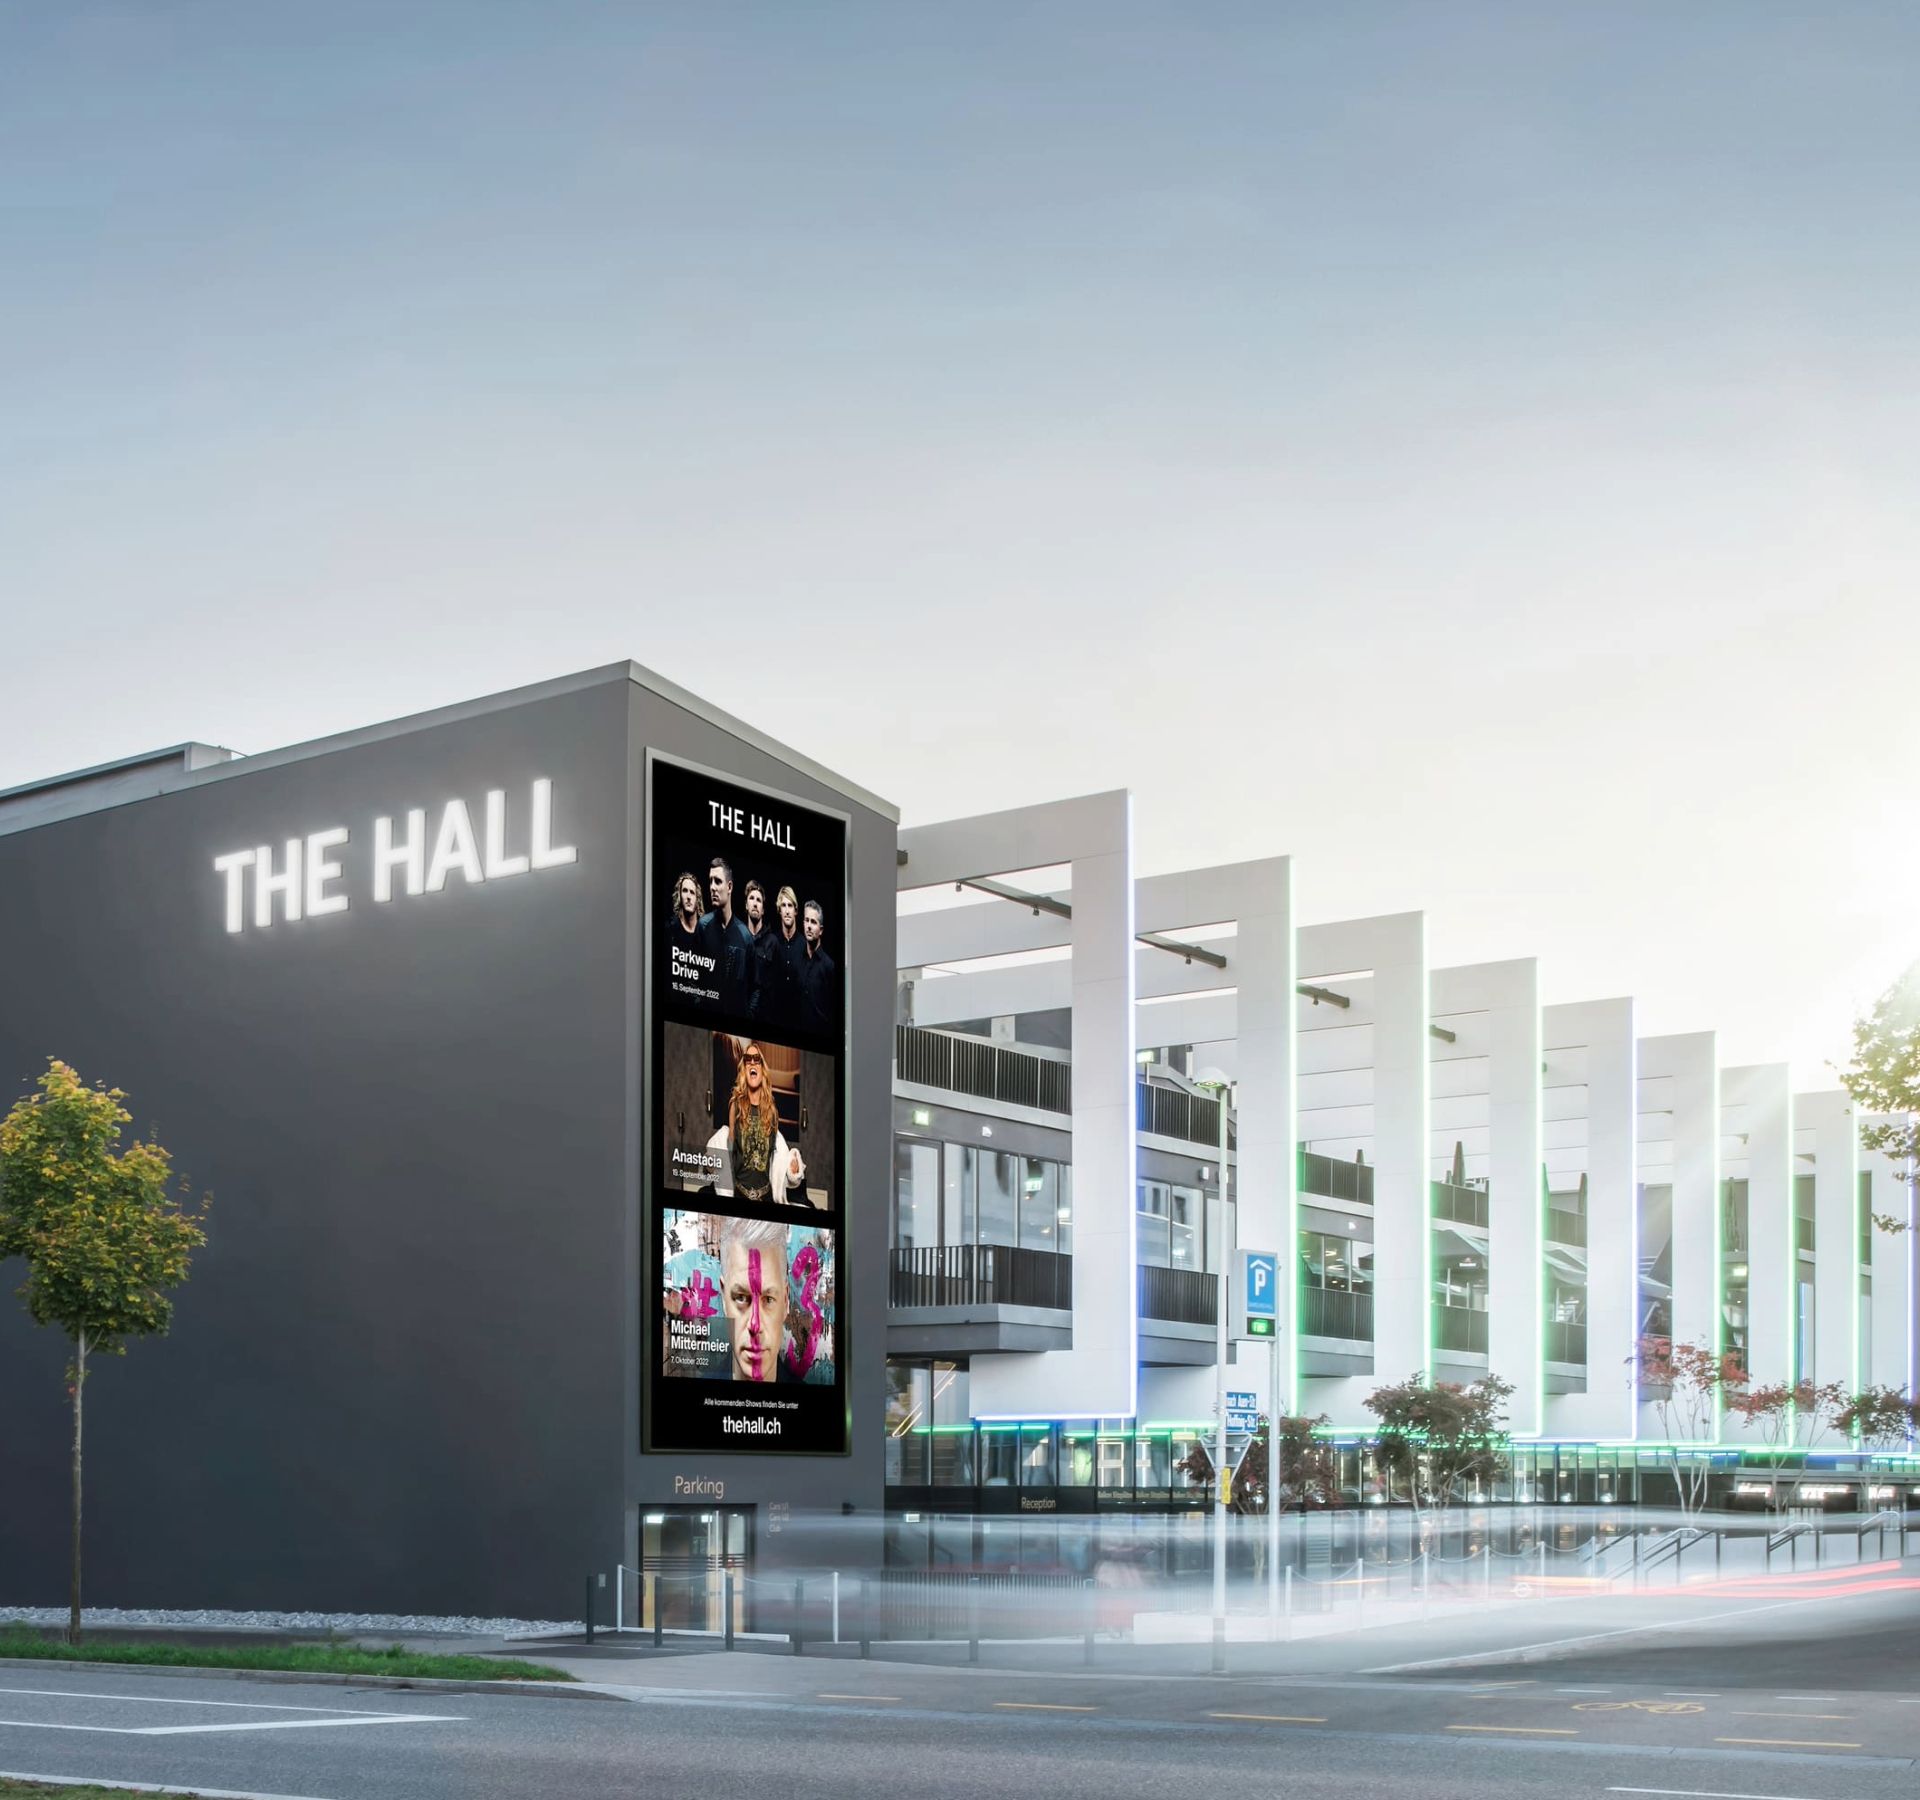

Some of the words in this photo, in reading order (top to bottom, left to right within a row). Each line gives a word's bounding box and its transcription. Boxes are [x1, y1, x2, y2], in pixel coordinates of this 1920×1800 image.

[708, 800, 745, 836] THE
[751, 813, 796, 851] HALL
[214, 826, 350, 934] THE
[373, 778, 579, 903] HALL
[672, 945, 716, 972] Parkway
[672, 961, 699, 980] Drive
[679, 983, 706, 995] September
[706, 989, 720, 1000] 2022
[672, 1147, 722, 1169] Anastacia
[680, 1169, 706, 1181] September
[706, 1173, 720, 1182] 2022
[671, 1319, 711, 1336] Michael
[671, 1335, 730, 1353] Mittermeier
[675, 1355, 696, 1366] Oktober
[695, 1357, 709, 1366] 2022
[704, 1397, 714, 1406] Alle
[714, 1397, 746, 1407] kommenden
[745, 1398, 762, 1408] Shows
[762, 1399, 778, 1409] finden
[777, 1400, 786, 1409] Sie
[722, 1415, 782, 1434] thehall.ch
[674, 1475, 724, 1500] Parking
[1021, 1496, 1057, 1512] Reception
